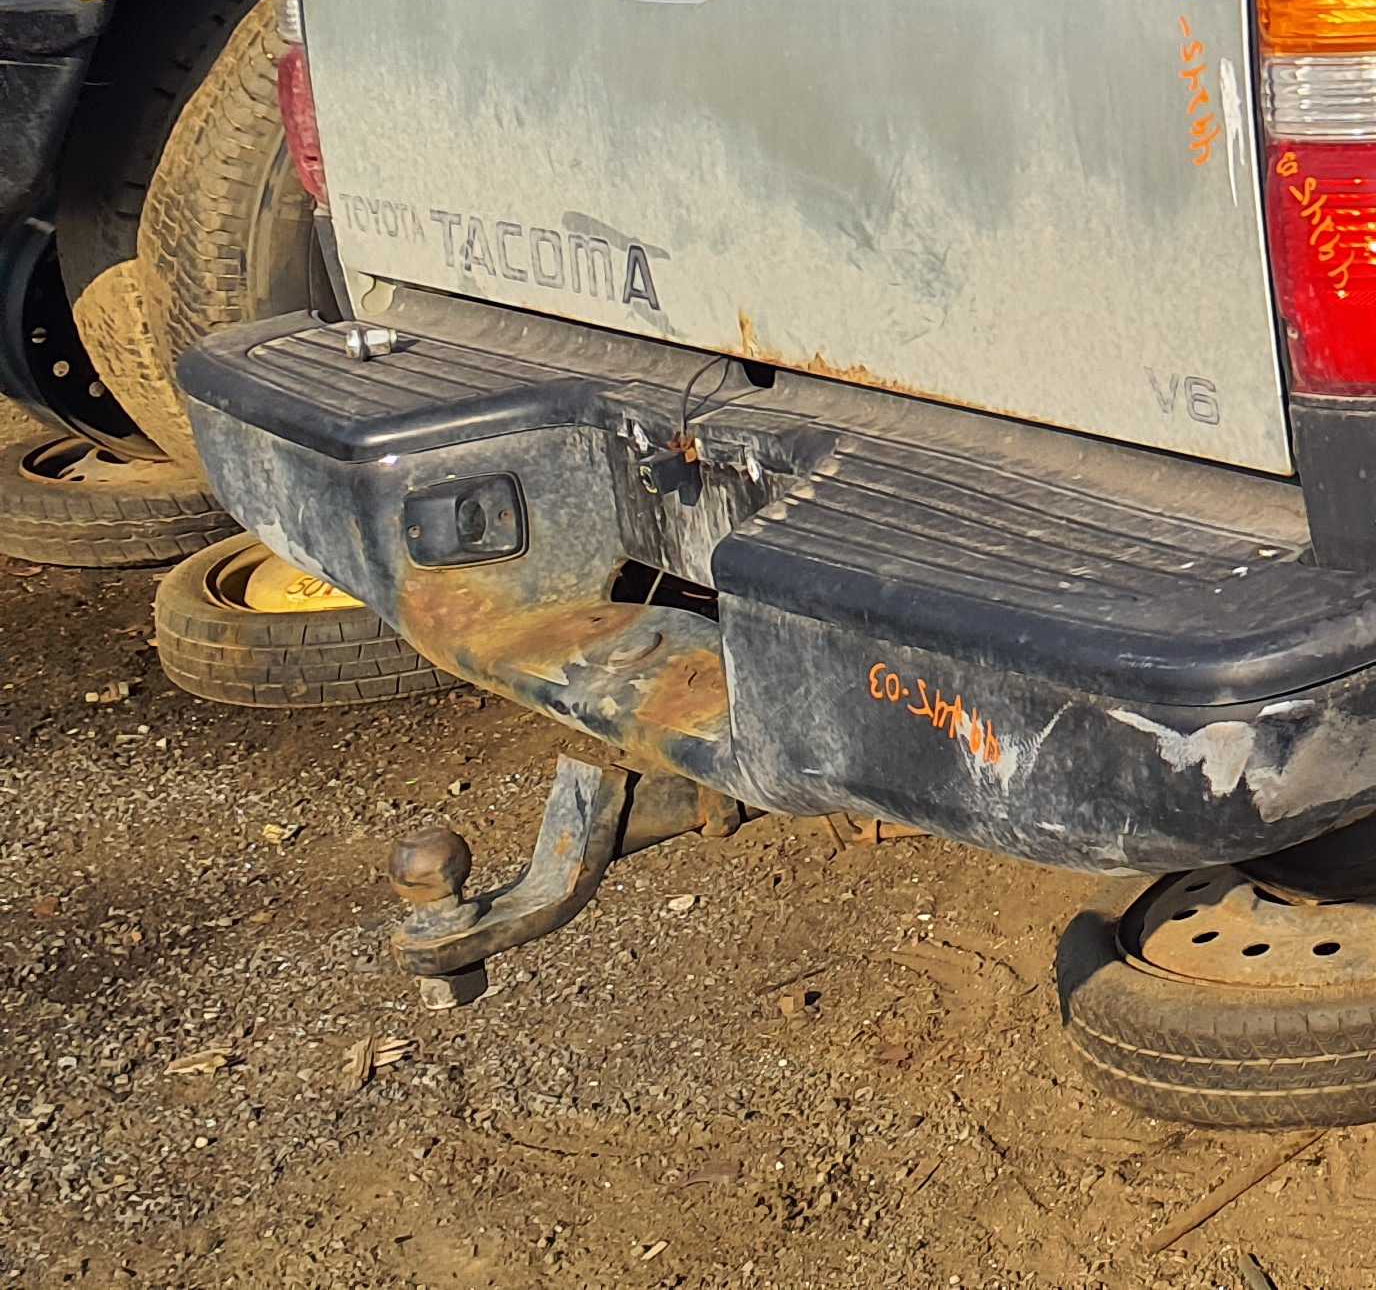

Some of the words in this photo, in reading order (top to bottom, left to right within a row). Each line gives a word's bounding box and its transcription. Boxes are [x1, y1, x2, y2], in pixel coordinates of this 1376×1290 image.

[338, 193, 426, 240] TOYOTA
[429, 208, 661, 311] TACOMA
[1143, 365, 1220, 426] V6
